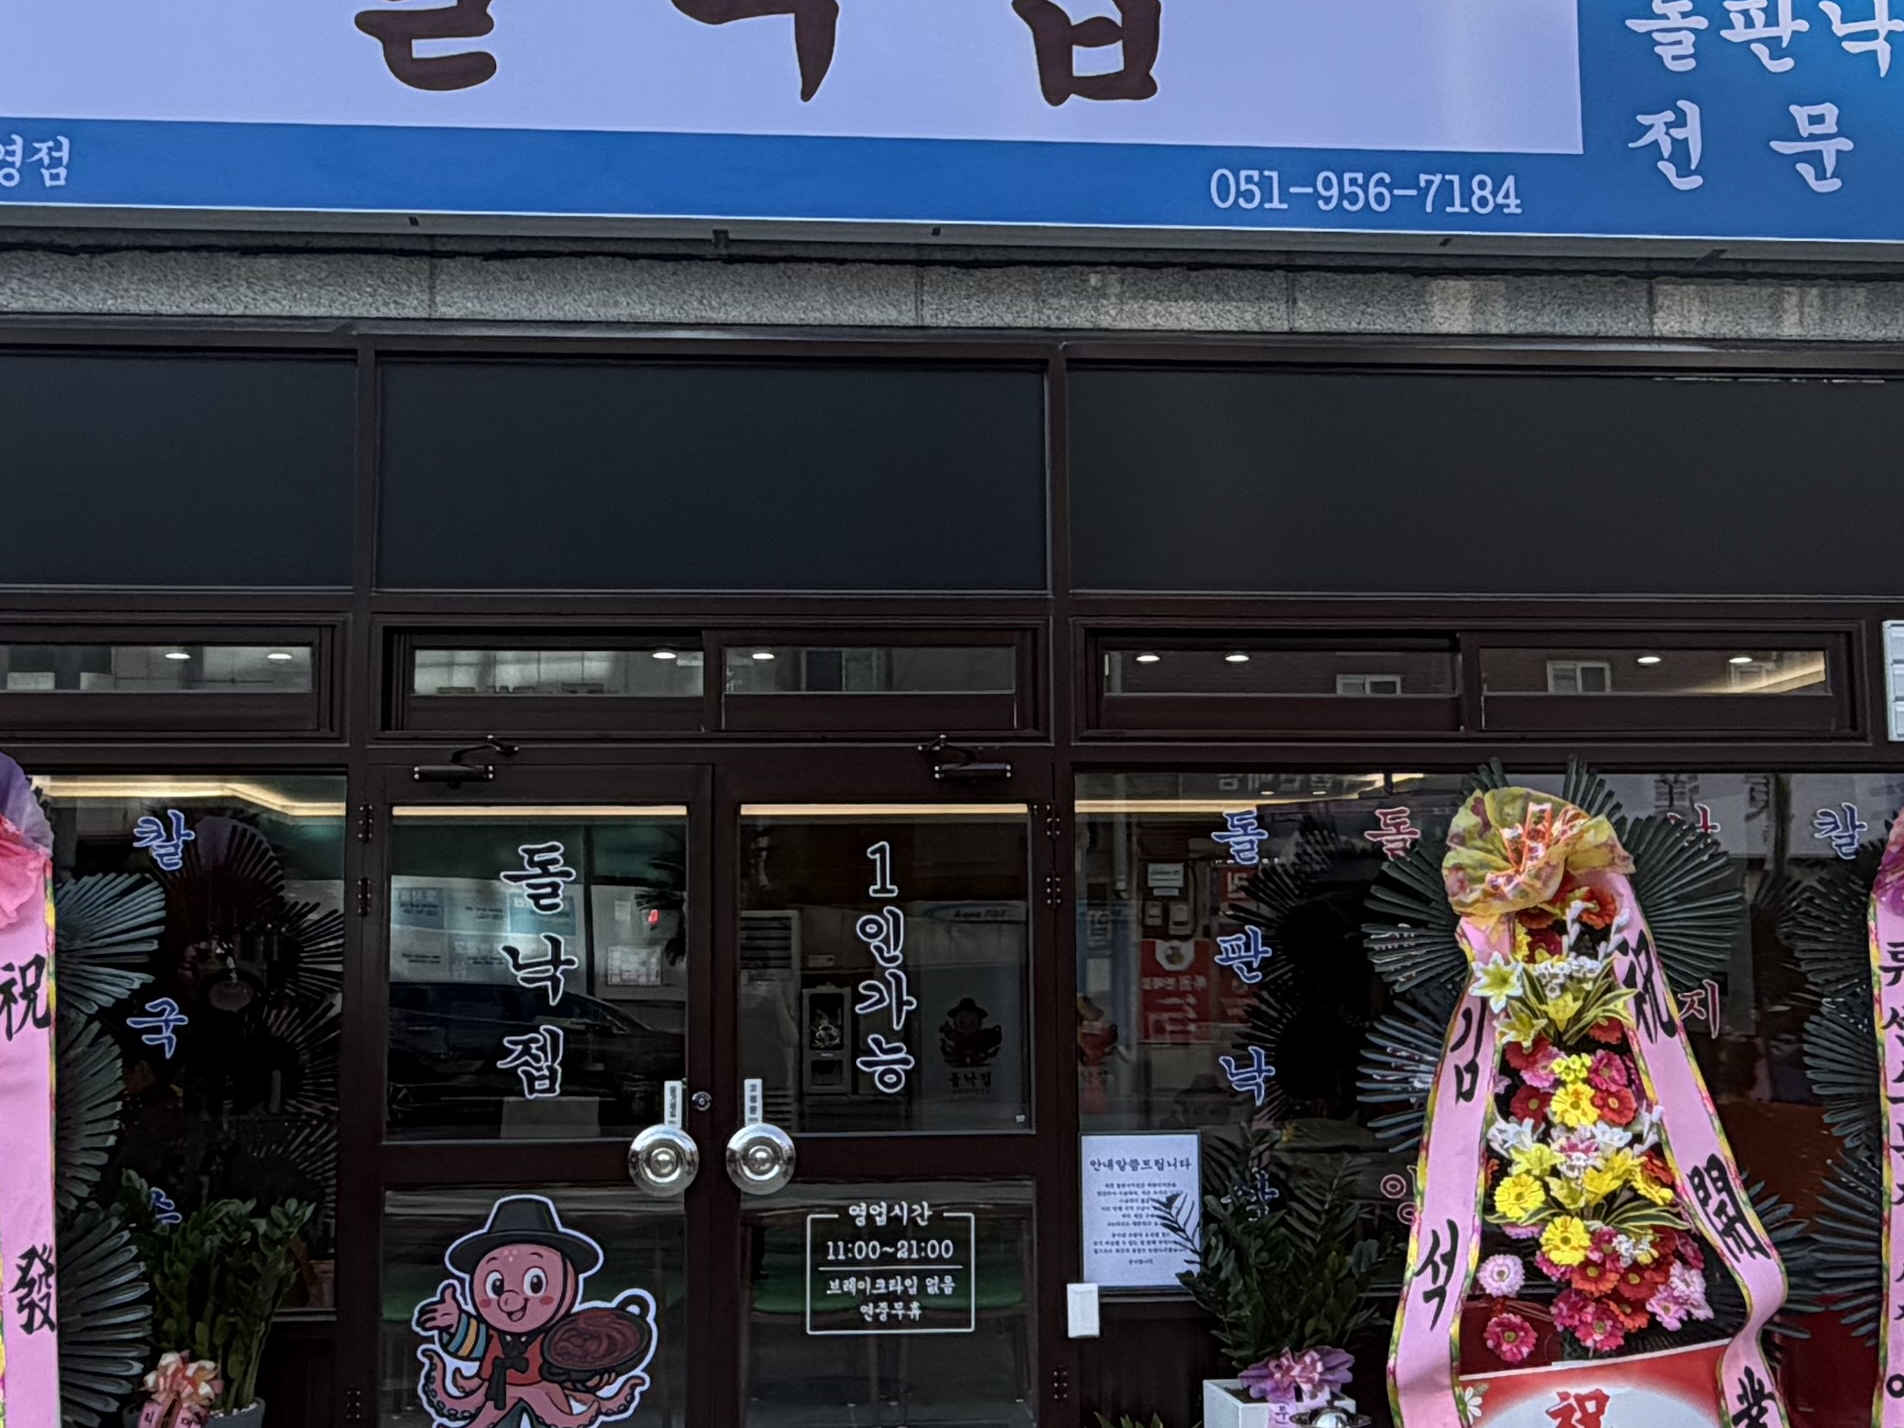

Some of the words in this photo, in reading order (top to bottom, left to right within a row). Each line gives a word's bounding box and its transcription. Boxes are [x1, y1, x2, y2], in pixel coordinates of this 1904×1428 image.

[1209, 167, 1523, 217] 051-956-7184
[497, 841, 578, 1100] 돌낙집
[855, 840, 917, 1094] 1인가능
[848, 1200, 933, 1228] 영업시간
[826, 1239, 954, 1261] 11:00~21:00
[925, 1274, 956, 1296] 없음
[859, 1300, 923, 1323] 연중무휴
